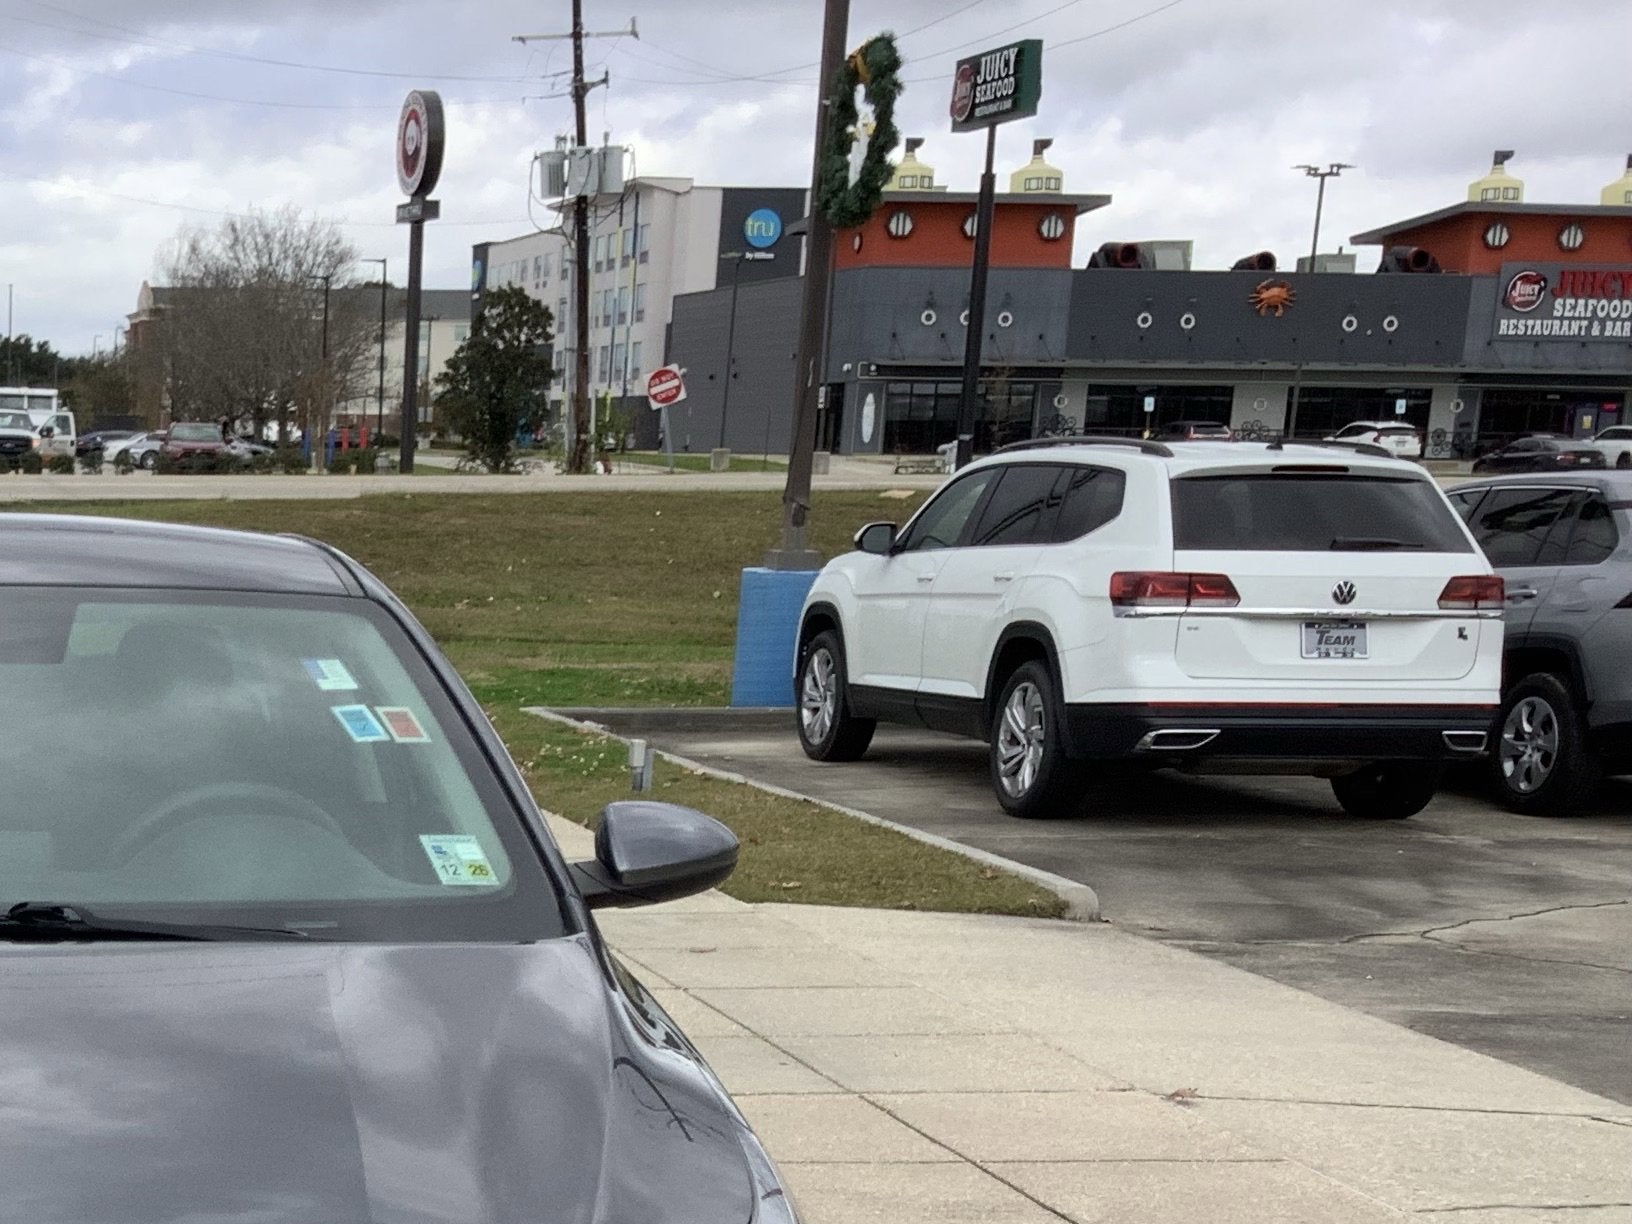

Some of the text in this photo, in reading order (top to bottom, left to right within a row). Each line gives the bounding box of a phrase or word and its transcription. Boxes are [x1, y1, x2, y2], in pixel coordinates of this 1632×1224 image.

[977, 47, 1019, 84] JUICY
[975, 76, 1015, 104] SEAFOOD
[745, 216, 775, 237] tru
[1553, 298, 1632, 318] SEAFOOD
[1498, 319, 1631, 337] RESTAURANT & BAR
[440, 863, 462, 876] 12
